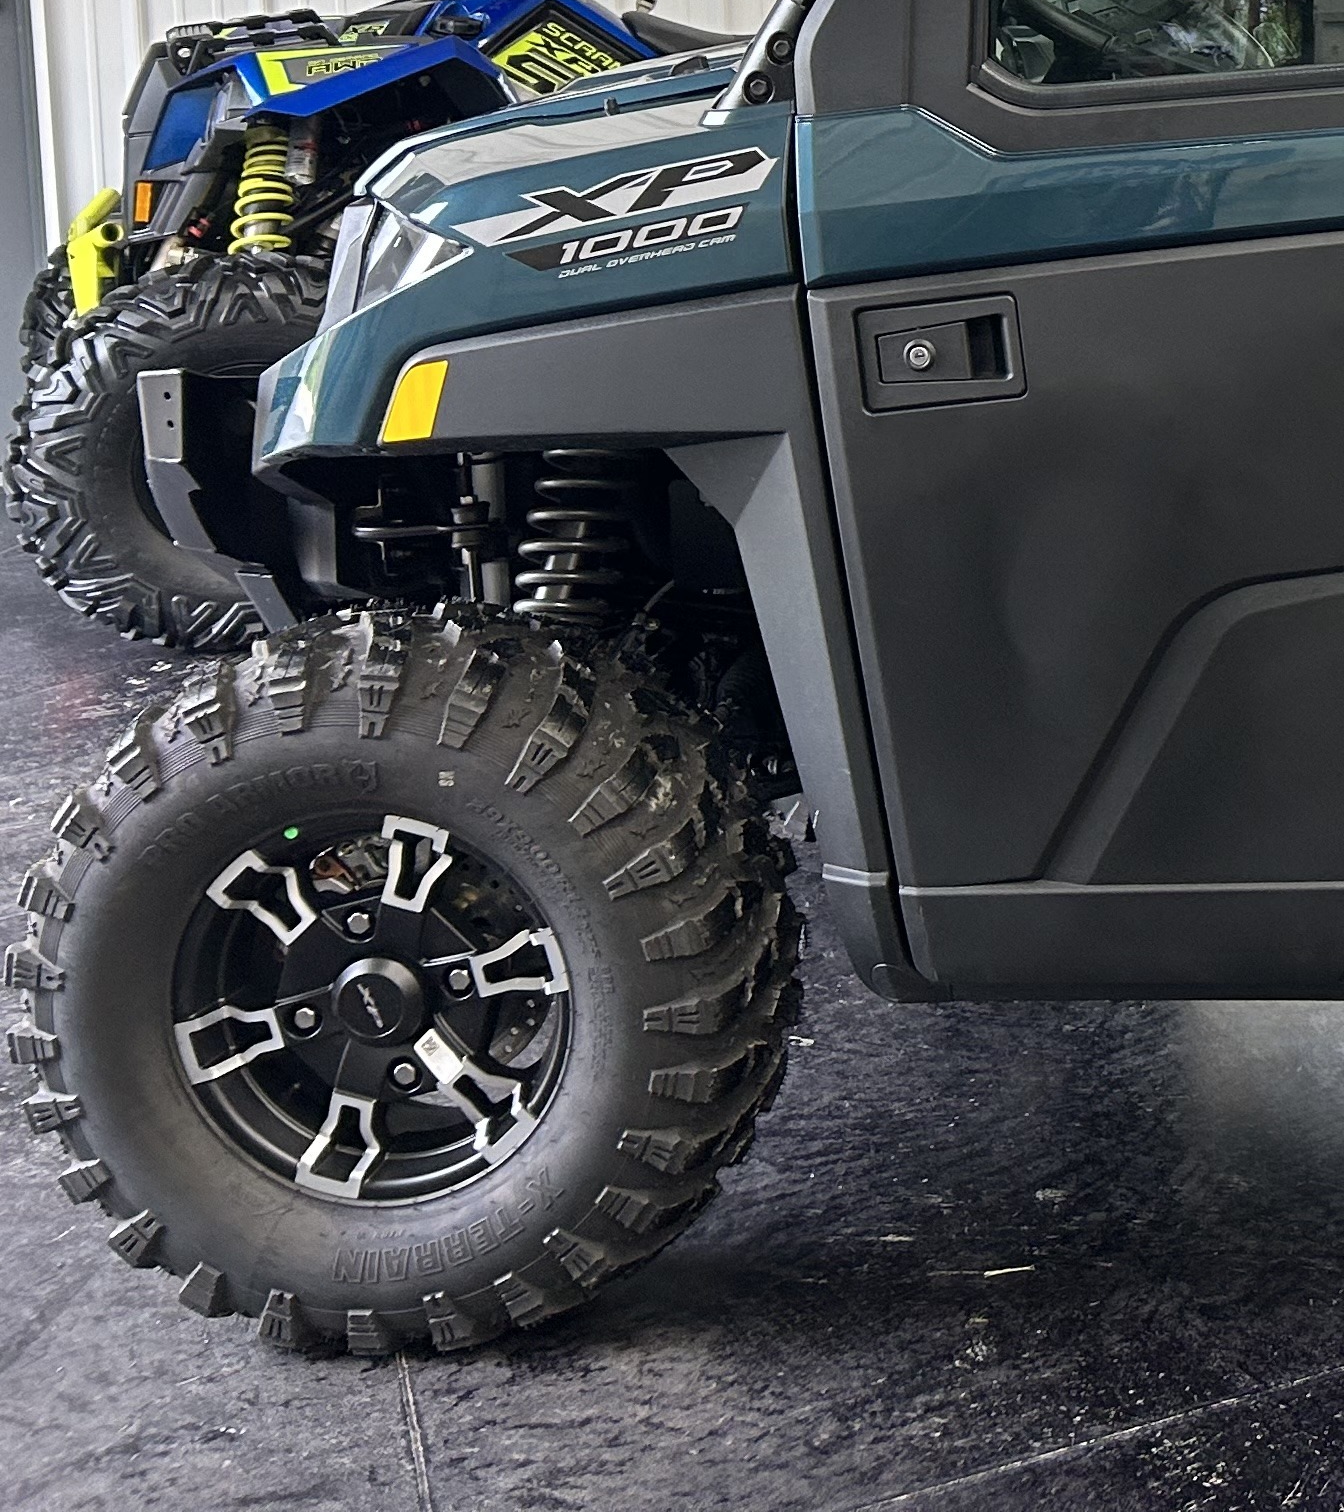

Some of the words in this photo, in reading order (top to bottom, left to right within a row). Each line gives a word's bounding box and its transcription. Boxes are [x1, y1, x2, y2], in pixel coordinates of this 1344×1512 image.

[493, 147, 768, 242] XP
[558, 264, 603, 279] DUAL
[606, 241, 696, 268] OVERHEAD
[698, 233, 737, 248] CAM
[559, 205, 745, 265] 1000
[332, 1166, 566, 1284] X-TERRAIN
